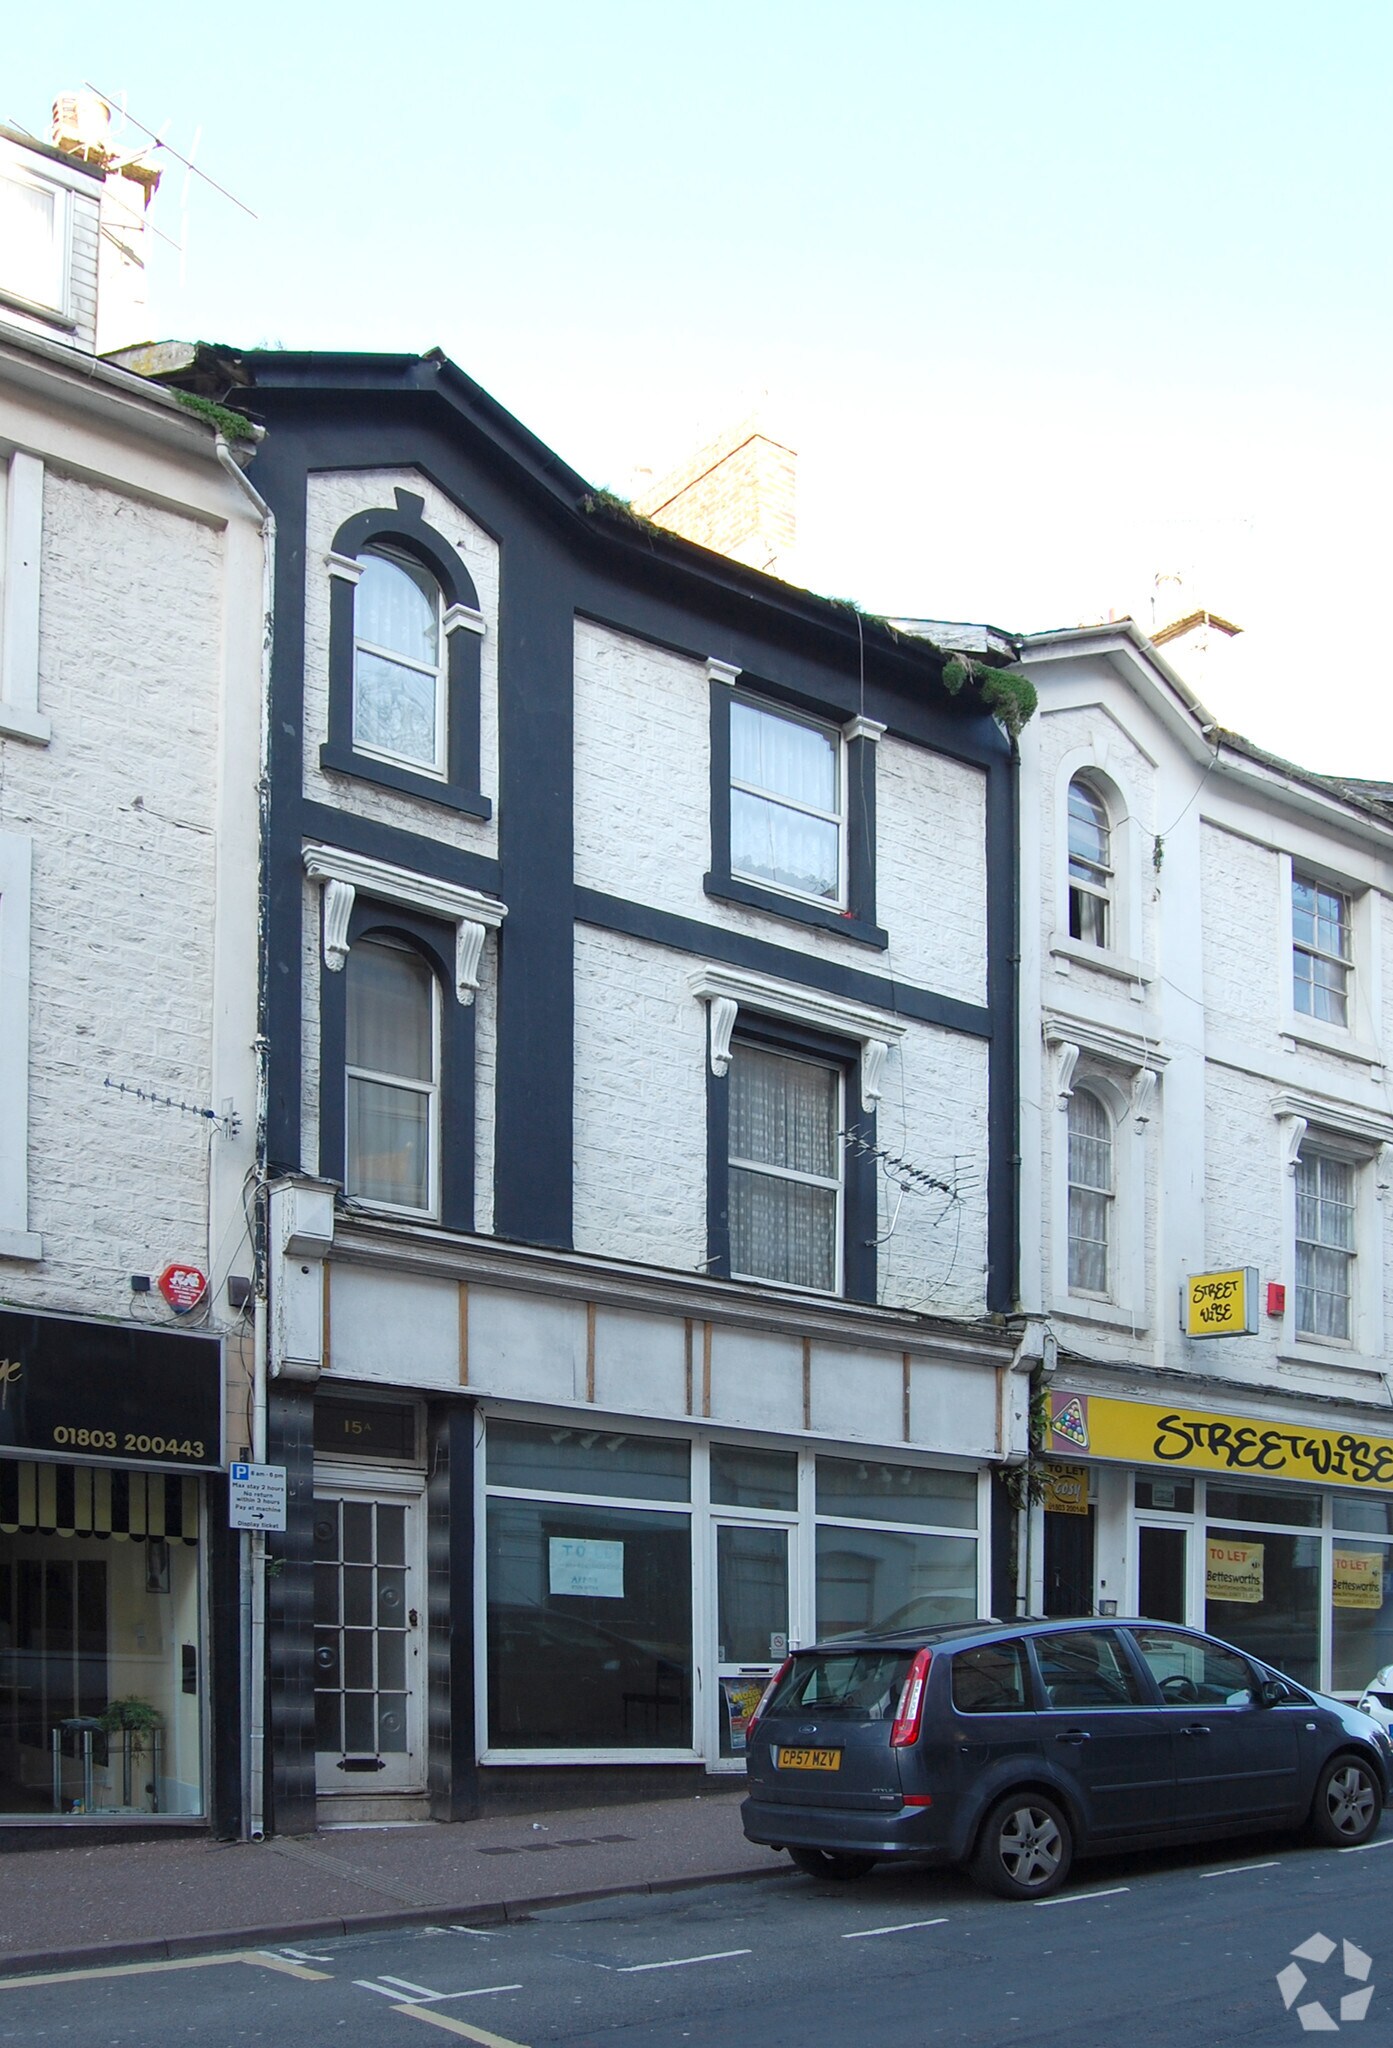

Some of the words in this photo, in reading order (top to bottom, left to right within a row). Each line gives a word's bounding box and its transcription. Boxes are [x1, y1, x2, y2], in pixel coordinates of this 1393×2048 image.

[1193, 1280, 1239, 1303] STREET
[53, 1425, 118, 1449] 01803
[124, 1433, 205, 1458] 200443
[237, 1466, 247, 1479] P
[1048, 1464, 1063, 1474] TO
[1066, 1466, 1085, 1475] LET
[247, 1483, 260, 1491] stay
[562, 1545, 586, 1558] TO
[1210, 1548, 1225, 1560] TO
[1227, 1550, 1248, 1563] LET
[1336, 1558, 1348, 1569] TO
[1350, 1560, 1369, 1571] LET
[1207, 1570, 1261, 1586] Bettesworths
[1333, 1579, 1380, 1593] Bettesworths
[782, 1751, 809, 1765] CP57
[813, 1753, 835, 1767] MZV
